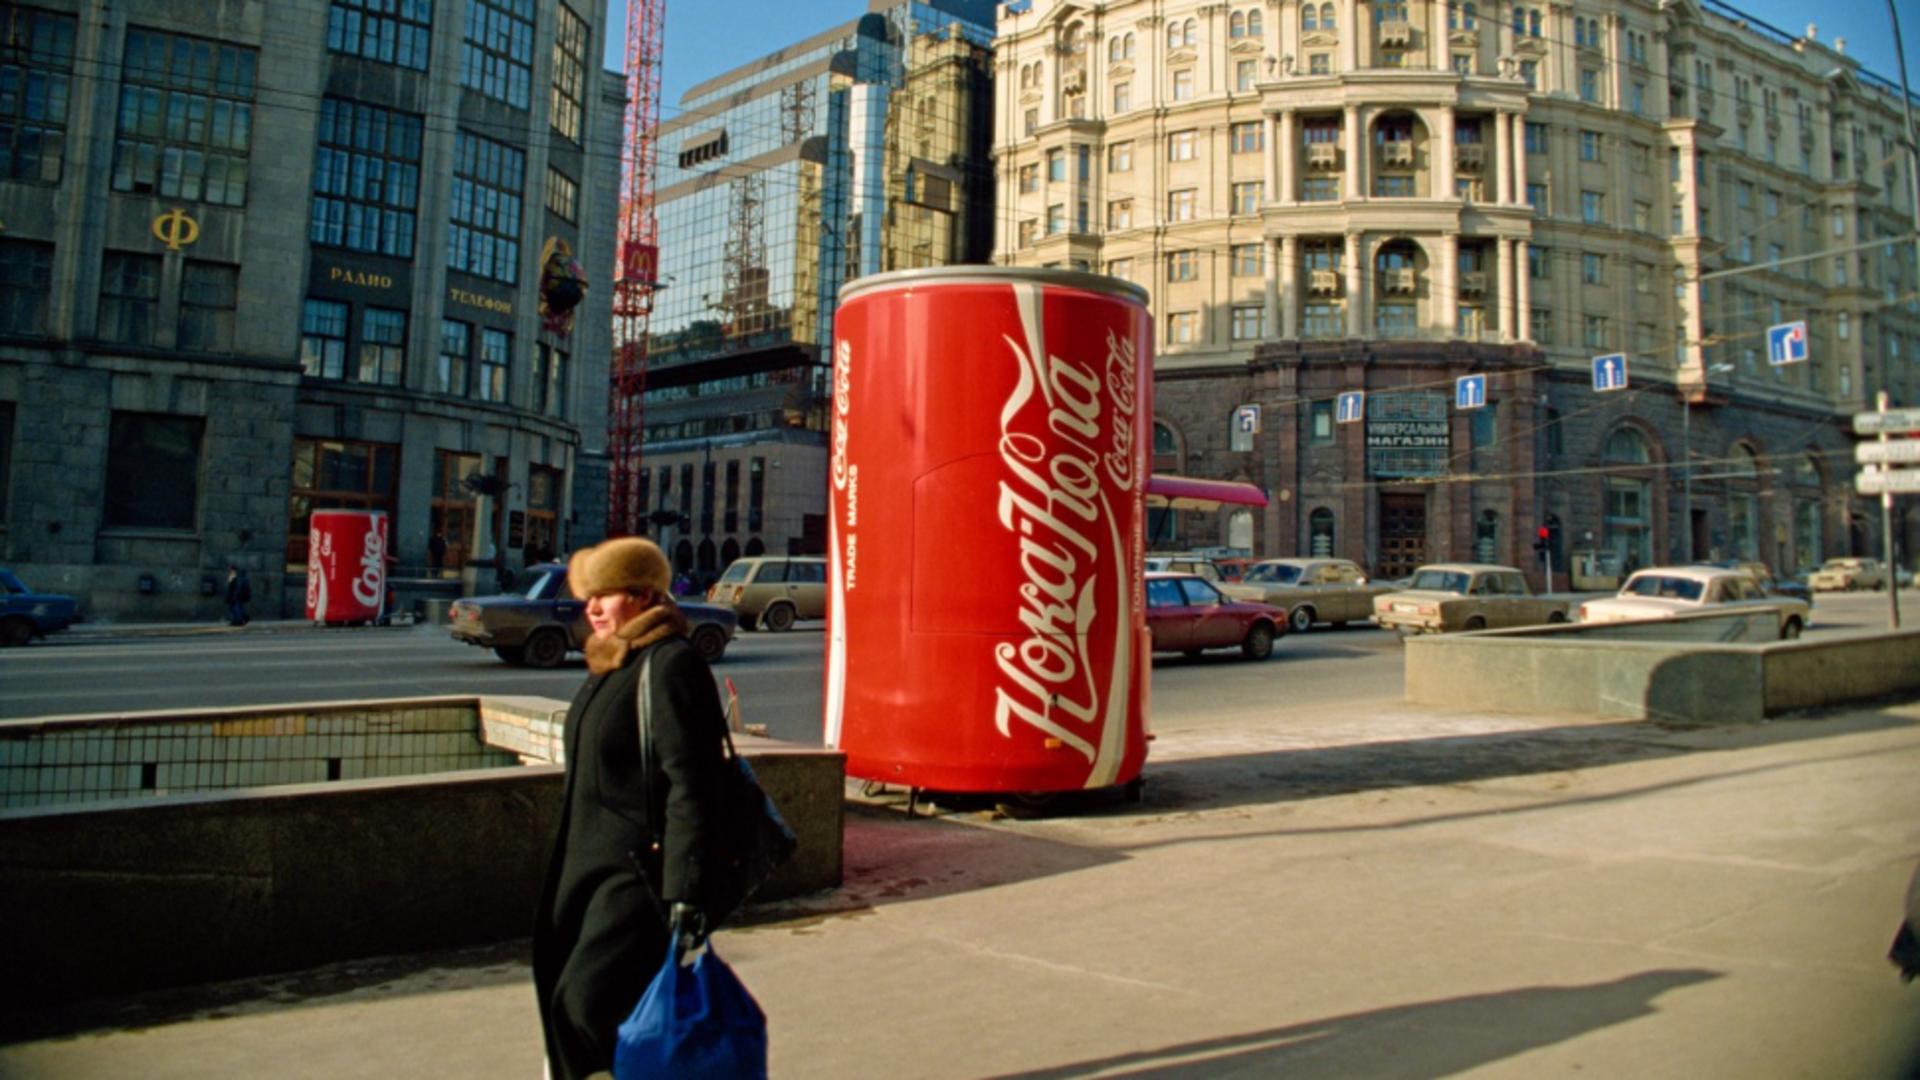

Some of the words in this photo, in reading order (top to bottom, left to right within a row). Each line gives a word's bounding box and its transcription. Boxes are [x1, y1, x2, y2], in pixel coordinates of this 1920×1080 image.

[152, 208, 199, 250] Ф
[331, 266, 393, 288] РАДИО
[451, 287, 512, 314] ТЕЛЕФОН
[1368, 436, 1449, 446] МАГАЗИН
[847, 464, 858, 526] MARKS
[352, 531, 381, 607] Coke
[846, 534, 857, 591] TRADE
